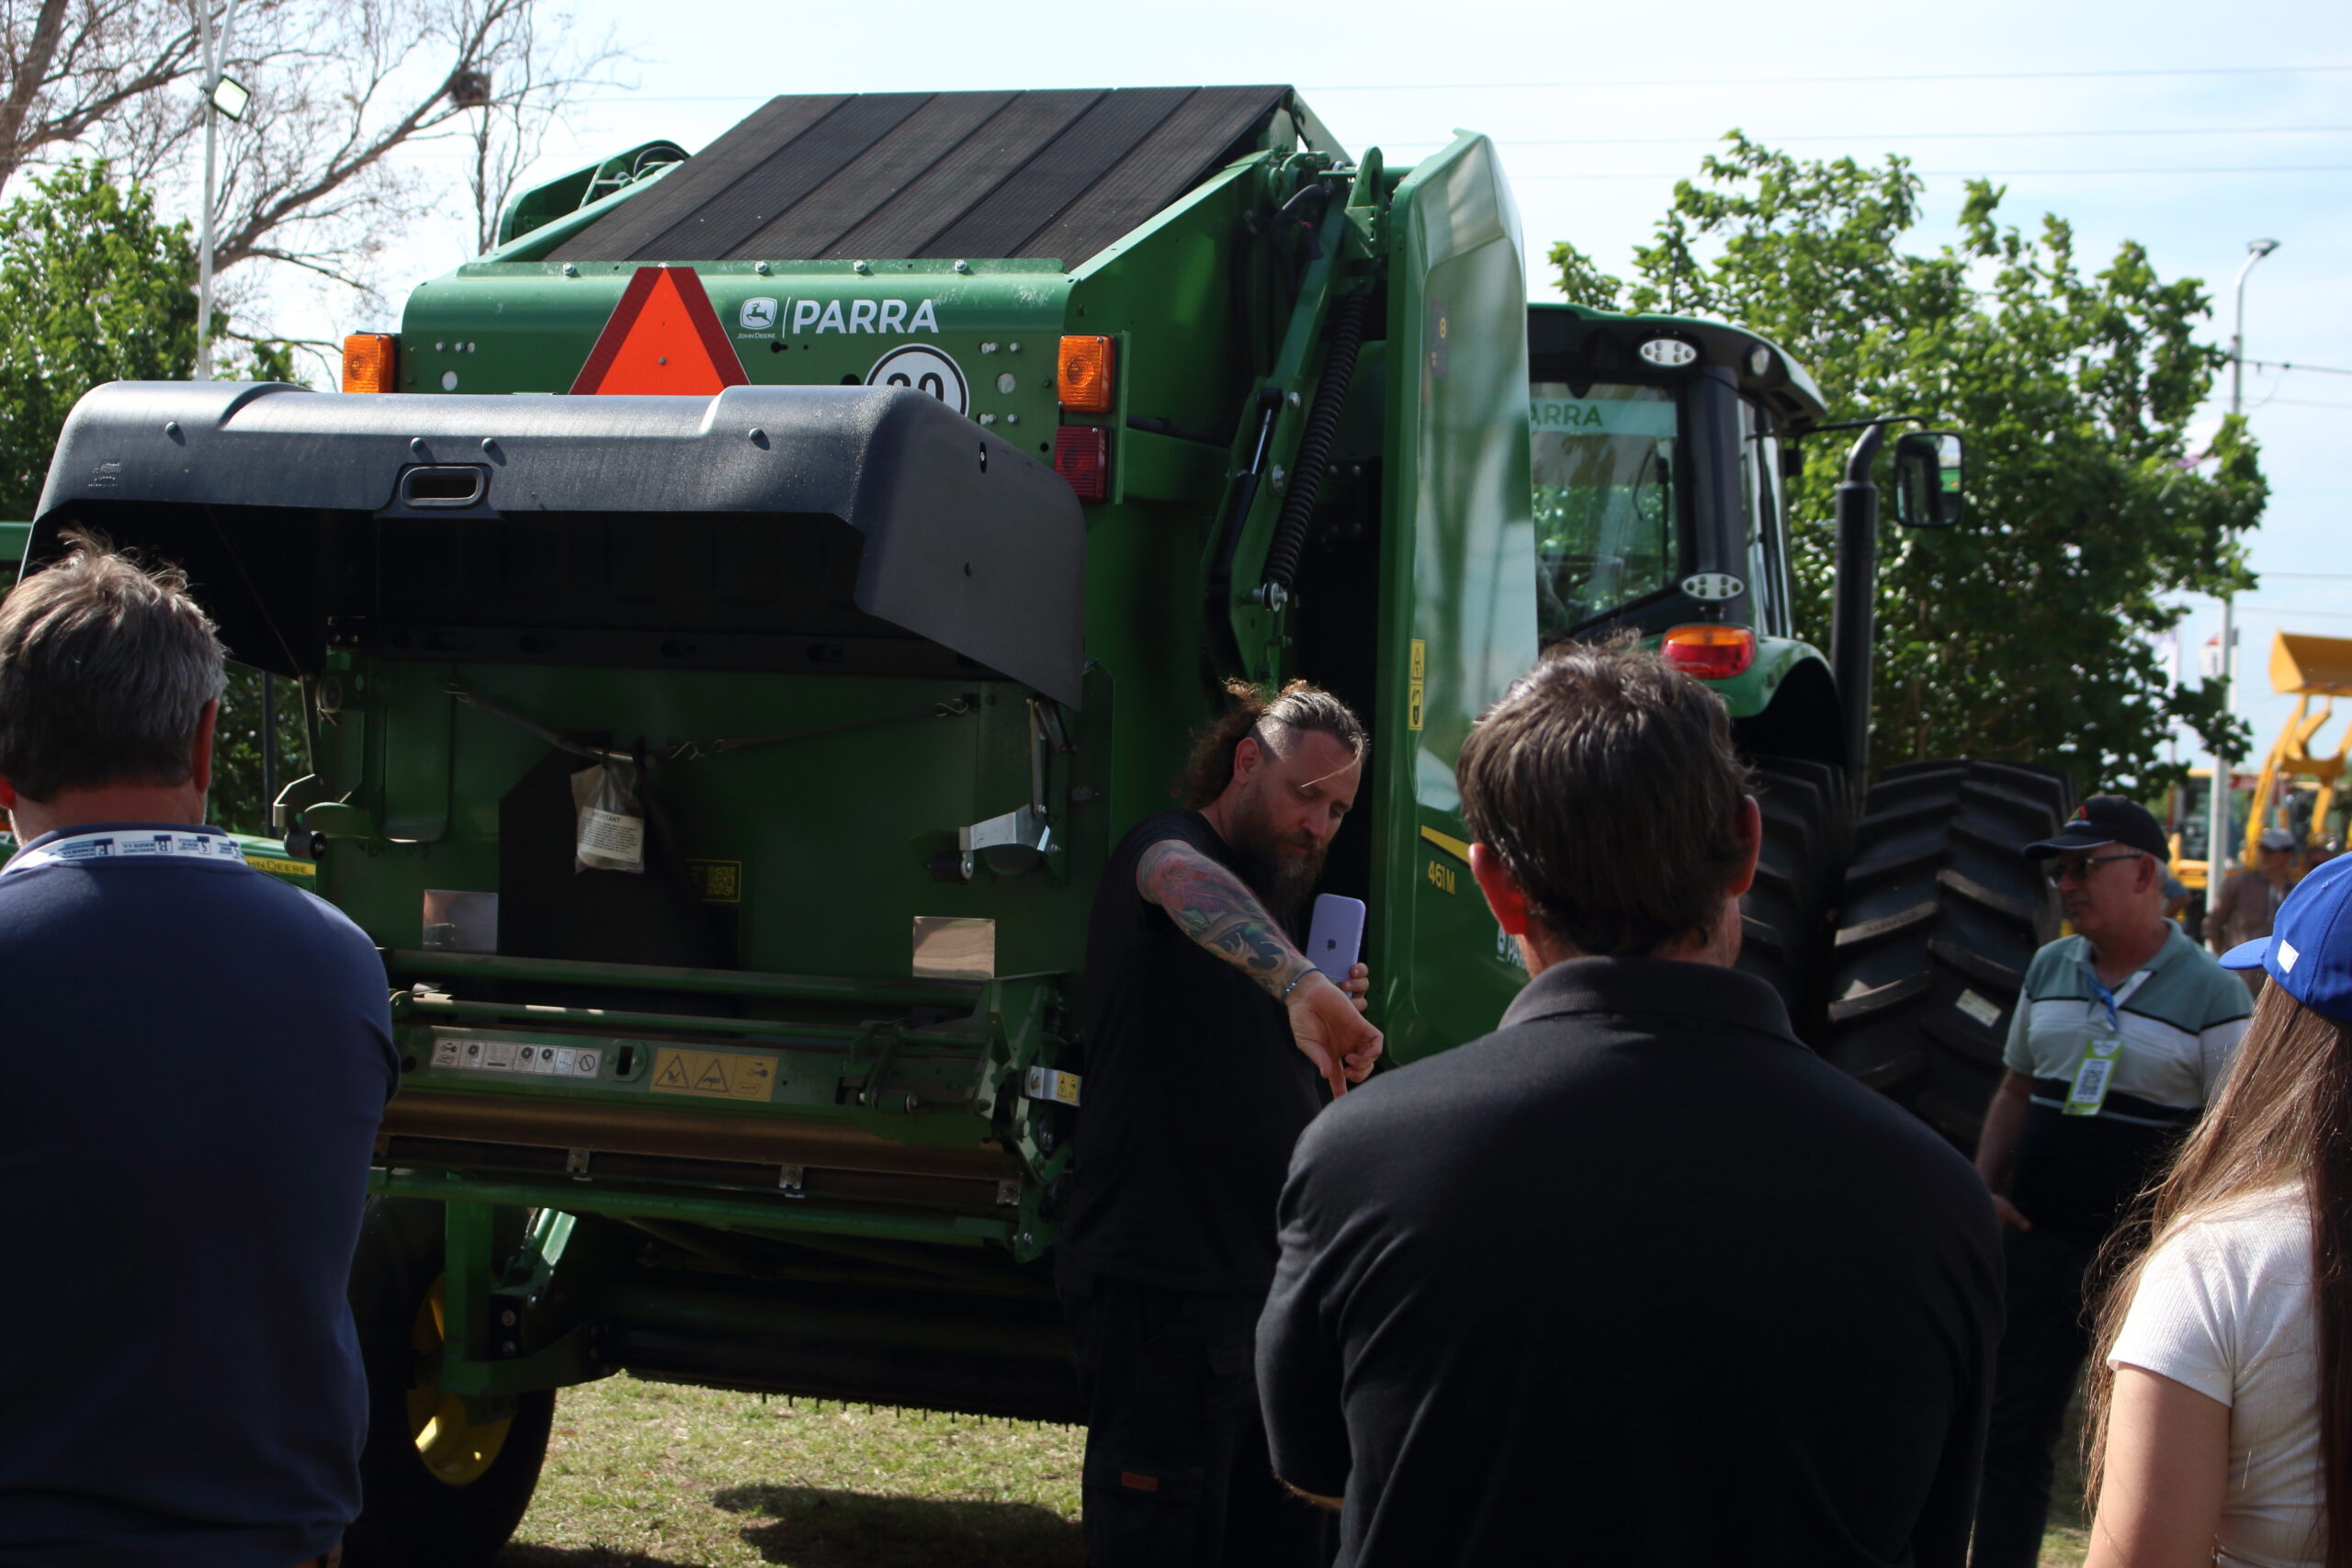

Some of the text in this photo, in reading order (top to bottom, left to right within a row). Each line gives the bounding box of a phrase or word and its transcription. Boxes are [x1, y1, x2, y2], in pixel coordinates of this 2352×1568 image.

[792, 299, 939, 334] PARRA
[1529, 402, 1603, 427] ARRA
[266, 861, 308, 874] DEERE
